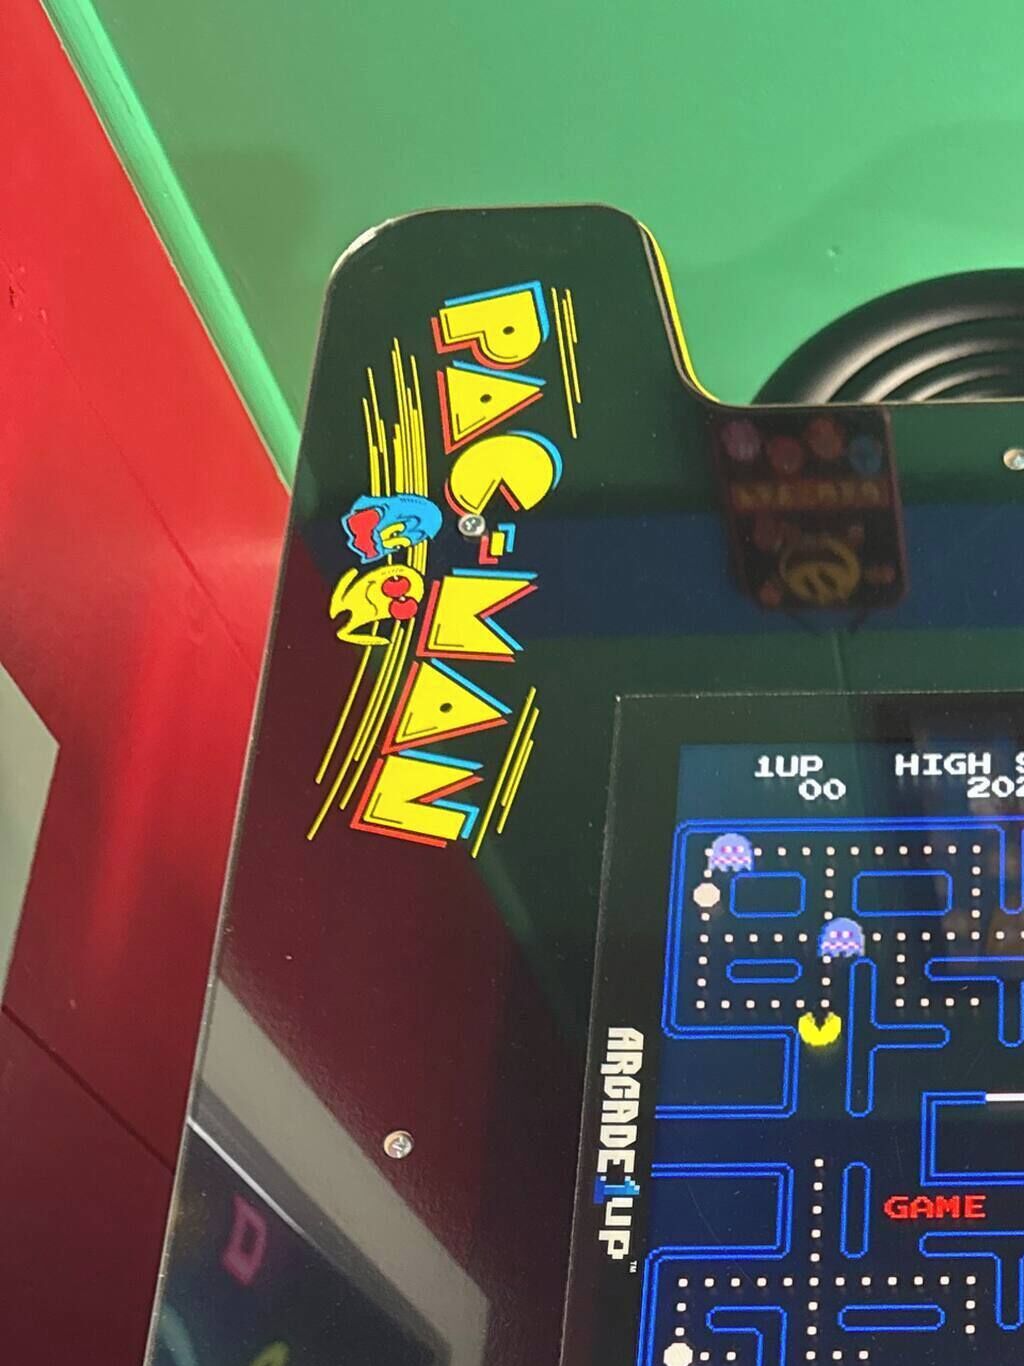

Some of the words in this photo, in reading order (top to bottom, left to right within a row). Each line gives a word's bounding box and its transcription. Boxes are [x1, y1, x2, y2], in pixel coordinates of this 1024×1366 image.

[350, 281, 563, 848] PAC-MAN
[754, 755, 824, 778] 1UP
[895, 753, 991, 776] HIGH
[799, 778, 847, 801] 00
[883, 1195, 987, 1219] GAME
